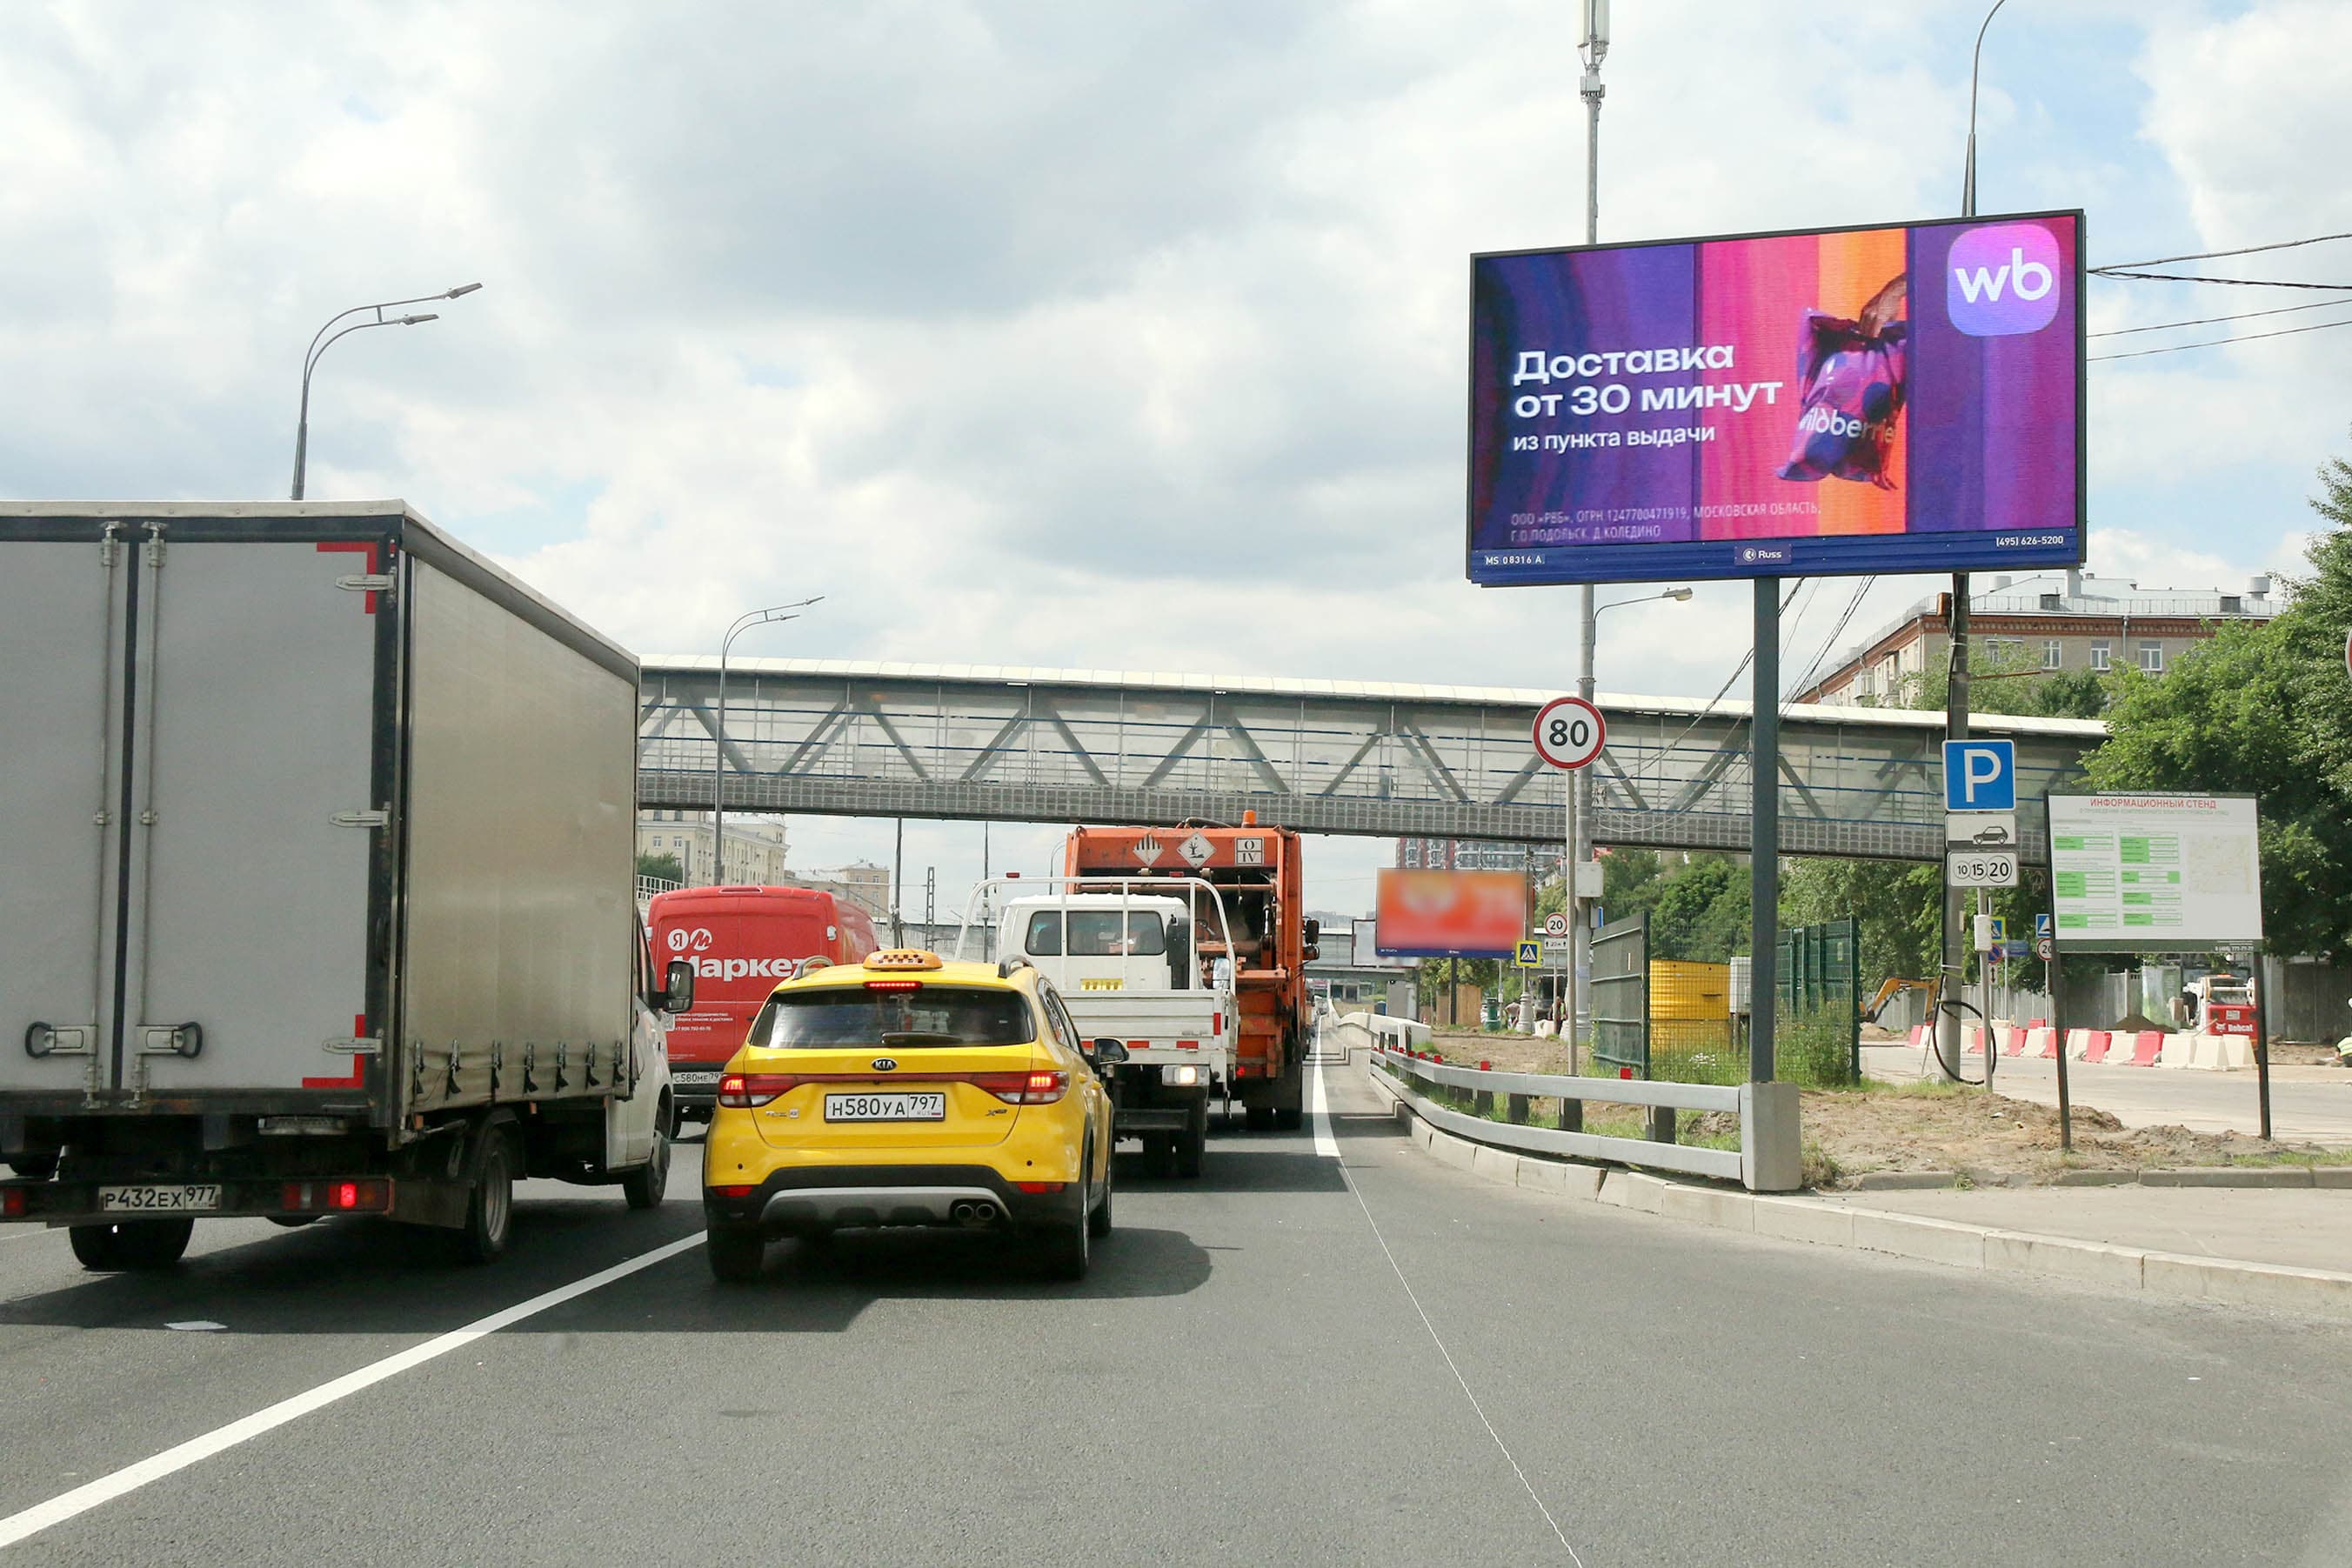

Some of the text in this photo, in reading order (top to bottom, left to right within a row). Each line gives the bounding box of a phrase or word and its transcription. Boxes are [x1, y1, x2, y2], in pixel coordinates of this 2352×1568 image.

[1954, 248, 2053, 304] wb
[1513, 345, 1734, 386] Доставка
[1514, 381, 1783, 418] от 30 минут
[1513, 426, 1715, 454] из пункта выдачи
[1576, 509, 1603, 523] ОГРН
[1694, 504, 1767, 518] МОСКОВСКАЯ
[1996, 535, 2064, 547] (495) 626-5200
[1486, 556, 1500, 565] MS
[1502, 555, 1532, 565] 08316
[1758, 550, 1782, 559] Russ
[1549, 719, 1589, 747] 80
[1964, 749, 2001, 803] P
[2090, 798, 2216, 810] ИНФОРМАЦИОННЫЙ СТЕНД
[1957, 863, 2009, 877] 10 15 20
[1550, 920, 1563, 930] 20
[875, 1060, 894, 1070] KIA
[910, 1096, 938, 1111] 797
[186, 1186, 217, 1202] 977
